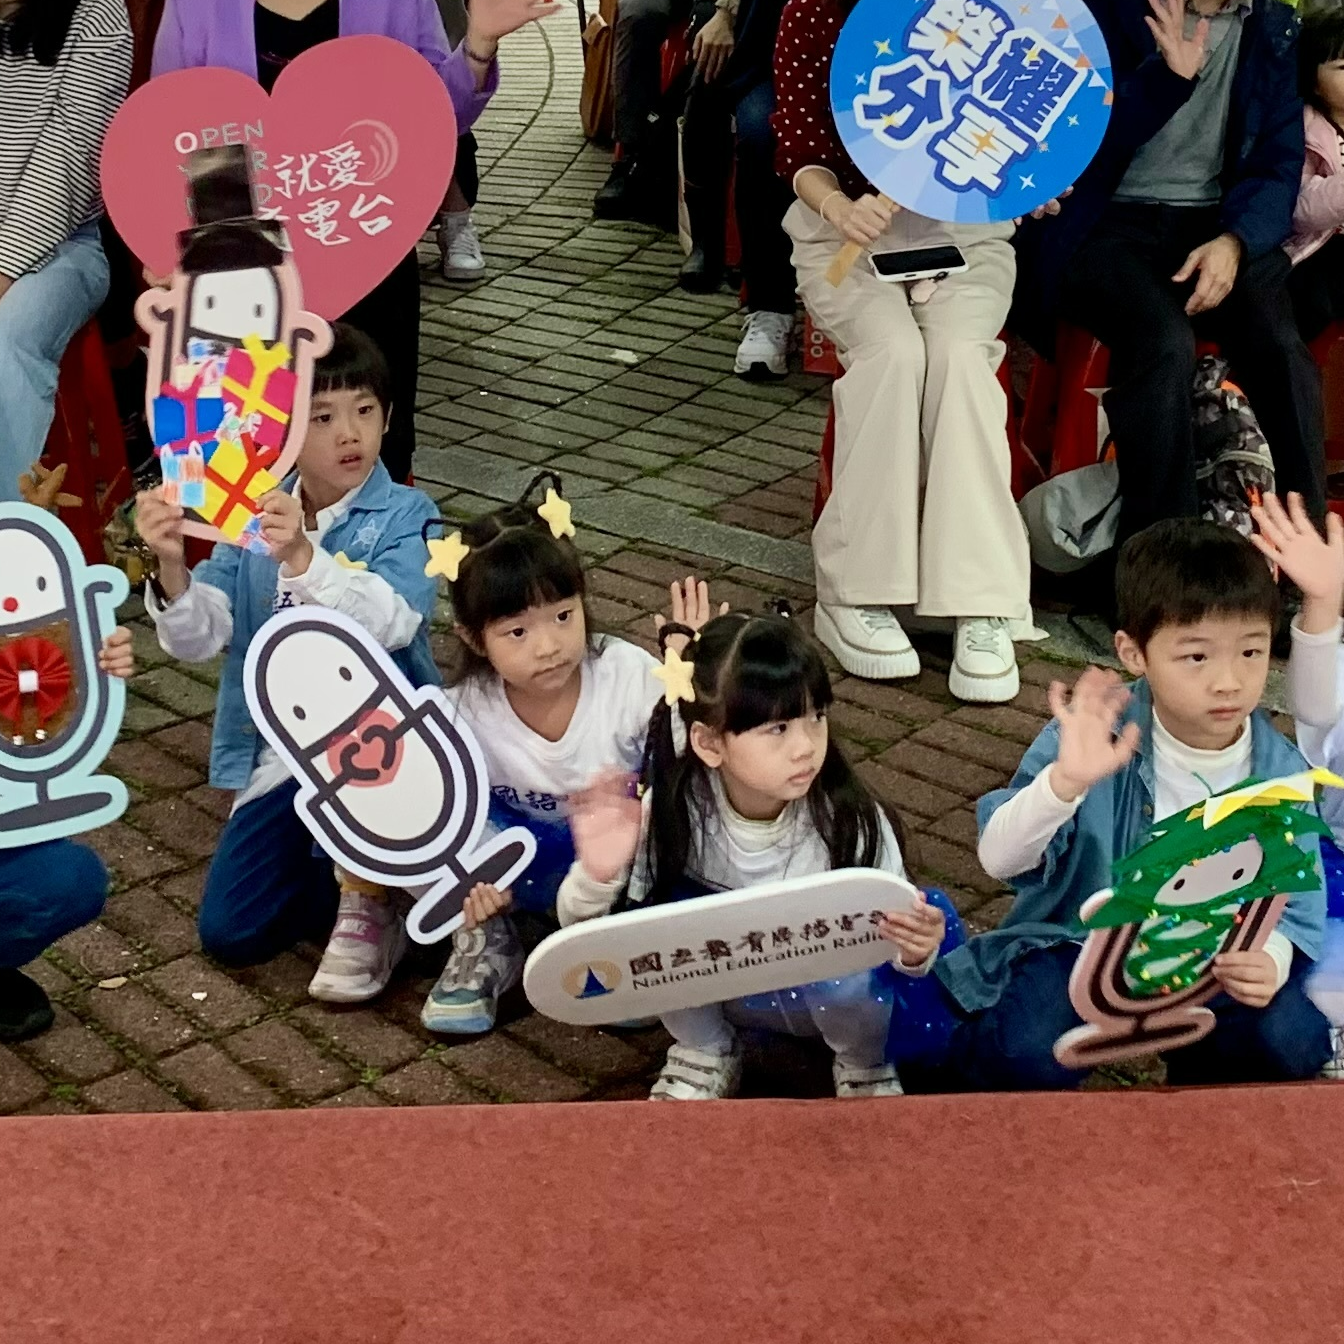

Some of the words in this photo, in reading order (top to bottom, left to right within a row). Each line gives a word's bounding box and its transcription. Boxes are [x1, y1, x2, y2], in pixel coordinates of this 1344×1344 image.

[174, 119, 264, 154] OPEN
[862, 64, 1030, 192] 分享
[273, 140, 375, 198] 就愛
[632, 962, 719, 991] National
[725, 942, 826, 971] Education
